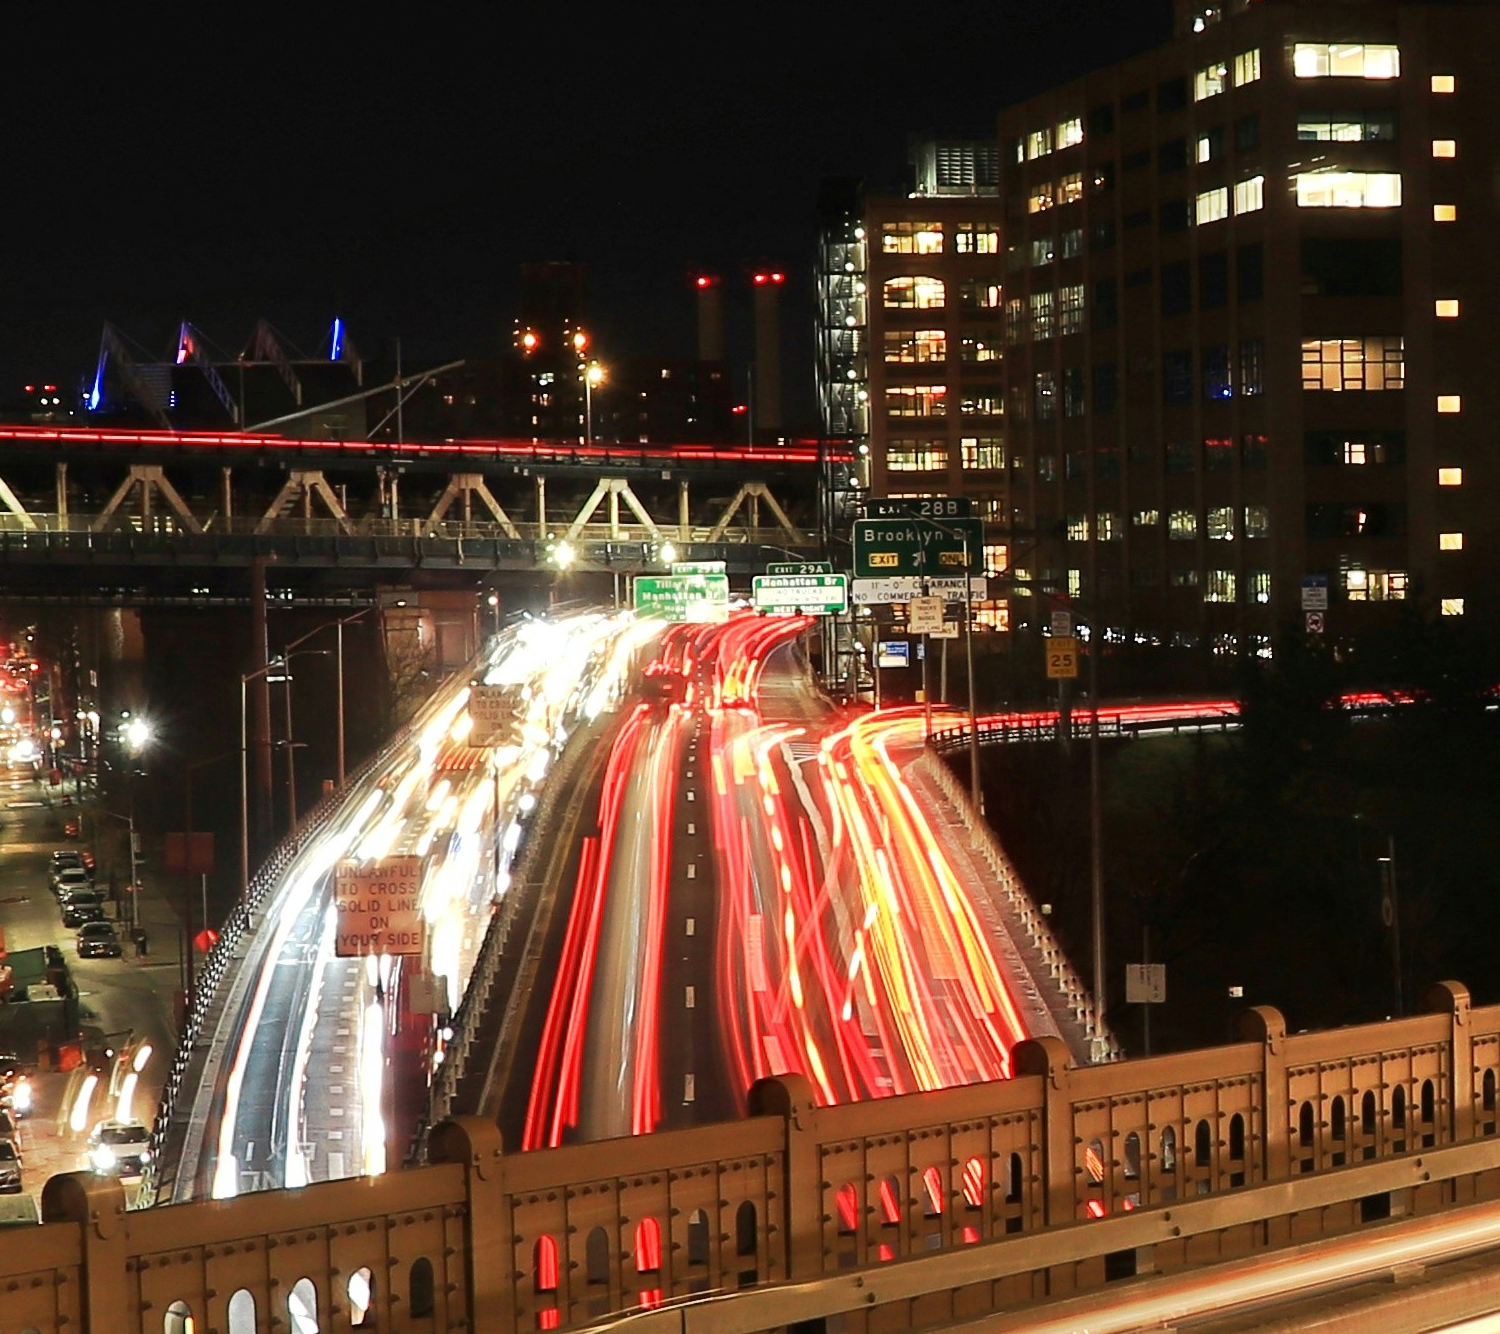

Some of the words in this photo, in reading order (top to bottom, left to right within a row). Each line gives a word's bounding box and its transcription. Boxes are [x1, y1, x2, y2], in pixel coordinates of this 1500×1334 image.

[921, 502, 958, 515] 28B
[864, 529, 943, 545] Brooklyn
[870, 554, 897, 565] EXIT
[800, 565, 824, 573] 29A
[761, 578, 818, 586] Manhattan
[824, 577, 838, 586] Br
[913, 580, 967, 589] CLEARANCE
[642, 592, 702, 600] Manhattan
[855, 593, 868, 601] NO
[878, 591, 935, 600] COMMERCL
[1051, 654, 1072, 667] 25
[340, 865, 417, 878] UNLAWFUL
[341, 883, 357, 895] TO
[369, 882, 417, 895] CROSS
[339, 900, 380, 913] SOLID
[388, 899, 420, 912] LINE
[370, 916, 389, 929] ON
[340, 933, 379, 946] YOUR
[387, 932, 419, 945] SIDE
